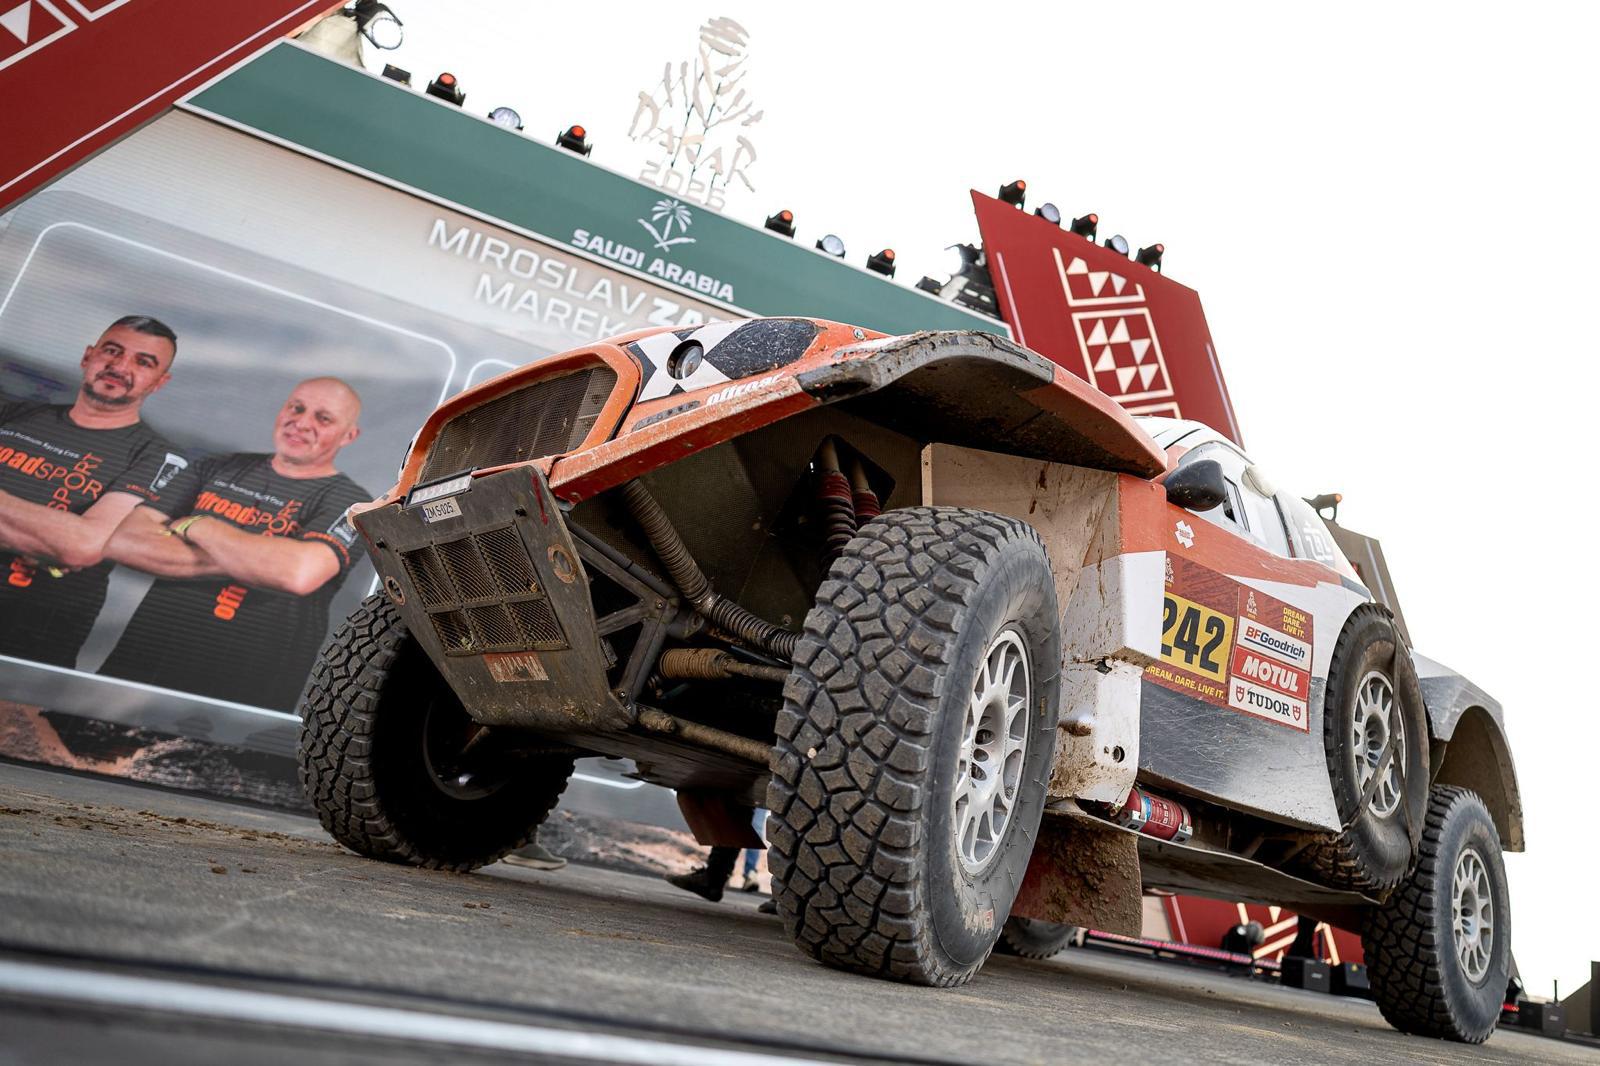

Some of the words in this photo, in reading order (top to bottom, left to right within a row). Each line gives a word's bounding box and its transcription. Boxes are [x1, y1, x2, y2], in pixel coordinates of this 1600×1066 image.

[428, 219, 646, 315] MIROSLAV
[648, 297, 722, 326] ZA
[571, 229, 645, 267] SAUDI
[649, 257, 735, 303] ARABIA
[474, 274, 626, 339] MAREK
[1283, 607, 1306, 623] DREAM.
[1283, 615, 1301, 628] DARE.
[1283, 624, 1296, 635] LIVE
[1161, 597, 1225, 674] 242
[1246, 625, 1305, 658] BFGoodrich
[1175, 675, 1197, 689] DARE.
[1198, 683, 1215, 696] LIVE
[1215, 689, 1224, 699] IT.
[1242, 656, 1298, 692] MOTUL
[1248, 690, 1291, 716] TUDOR
